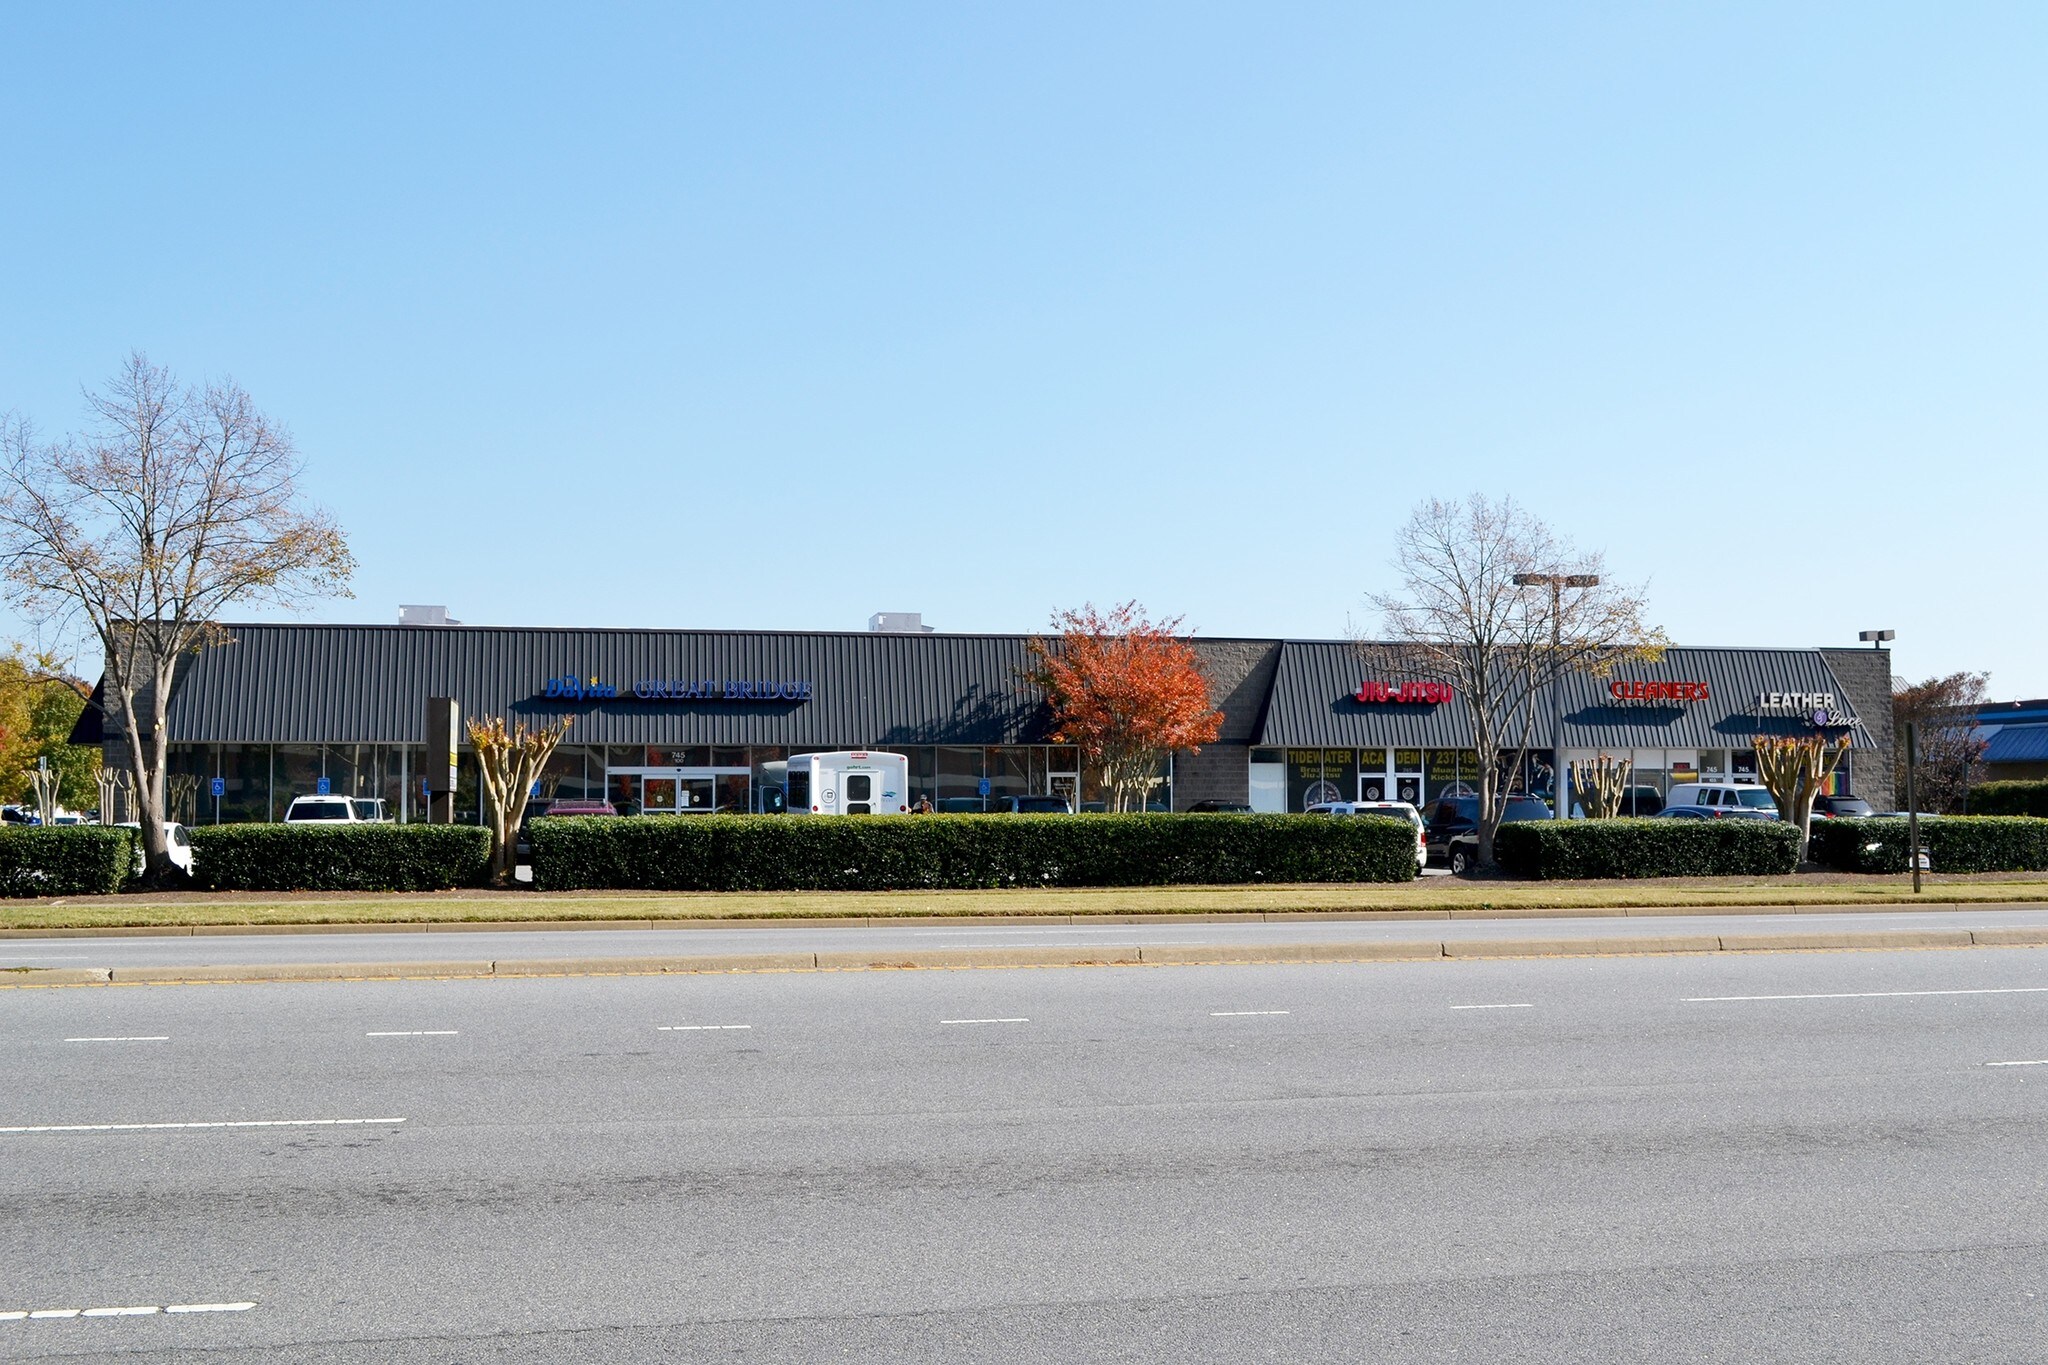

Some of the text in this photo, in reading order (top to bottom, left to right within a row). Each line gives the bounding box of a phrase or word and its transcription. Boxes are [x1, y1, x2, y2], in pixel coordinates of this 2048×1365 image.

[545, 675, 813, 701] DaVita GREAT BRIDGE
[1356, 681, 1453, 703] JIU-JITSU
[1611, 680, 1709, 702] CLEANERS
[1760, 692, 1834, 708] LEATHER
[671, 751, 686, 759] 745
[1288, 751, 1352, 764] TIDEWATER
[1436, 751, 1479, 764] 237-19
